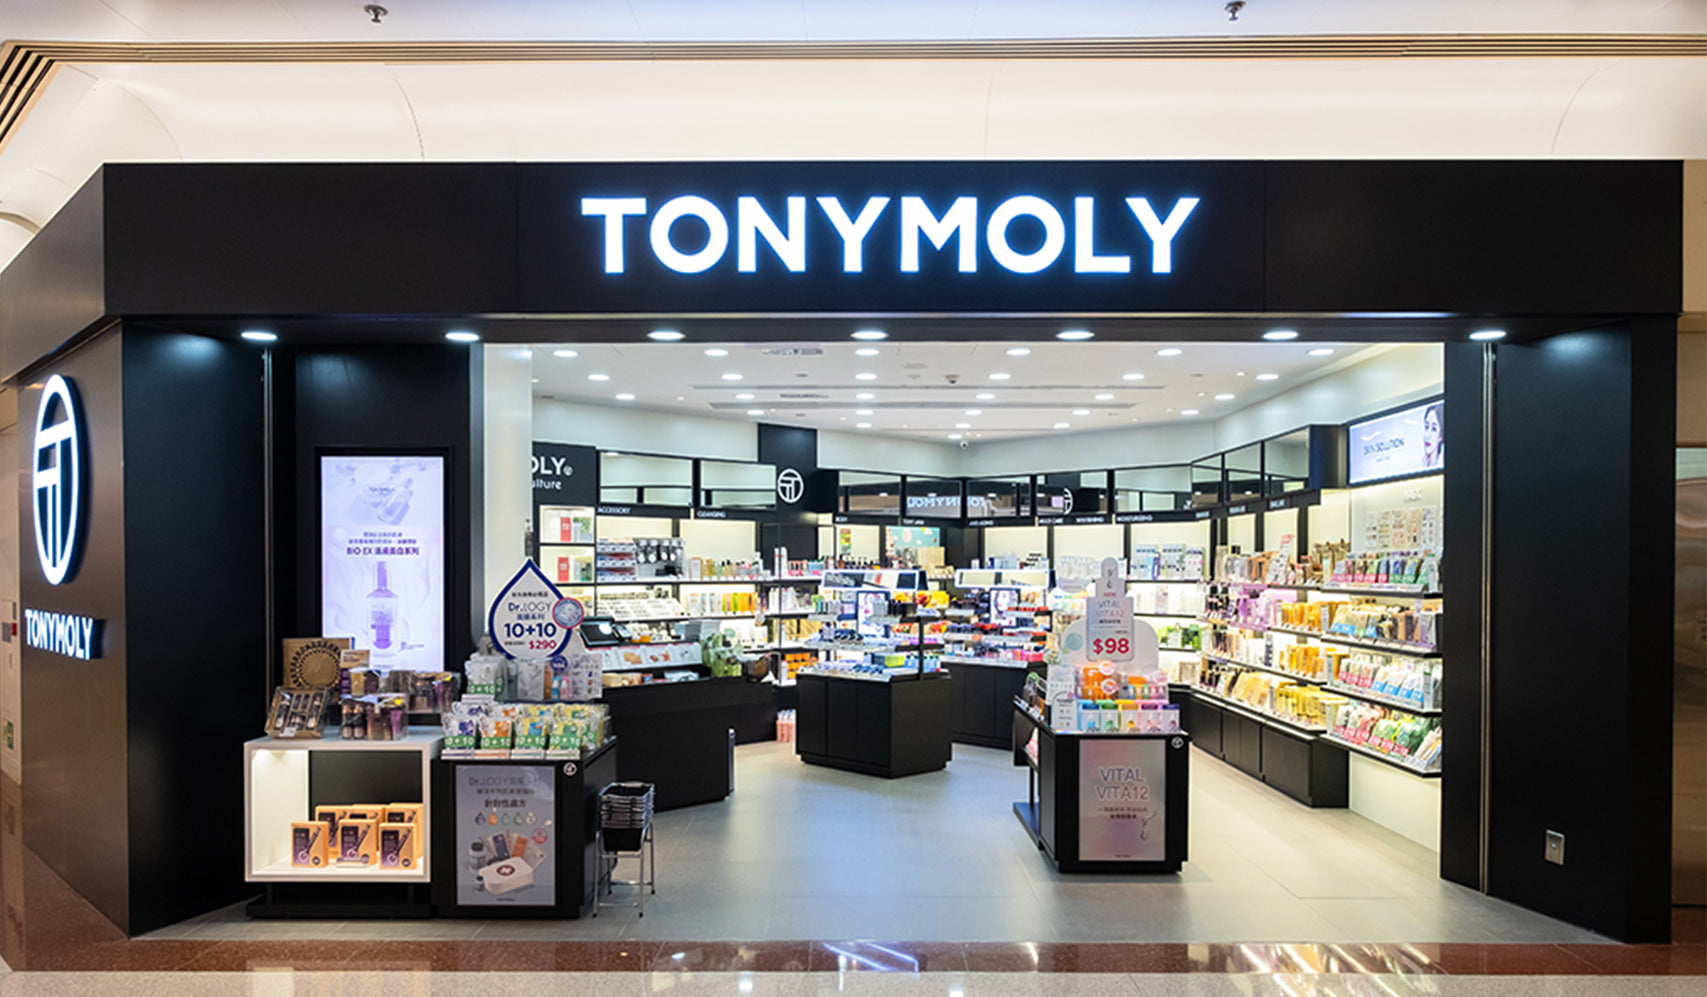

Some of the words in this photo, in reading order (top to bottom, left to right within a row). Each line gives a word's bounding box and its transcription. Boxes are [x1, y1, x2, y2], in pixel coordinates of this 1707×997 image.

[580, 194, 1200, 274] TONYMOLY
[24, 608, 94, 661] TONYMOLY
[504, 622, 557, 638] 10+10
[529, 639, 557, 650] $290
[1093, 637, 1130, 655] $98
[1100, 768, 1144, 782] VITAL
[1096, 785, 1149, 800] VITA12
